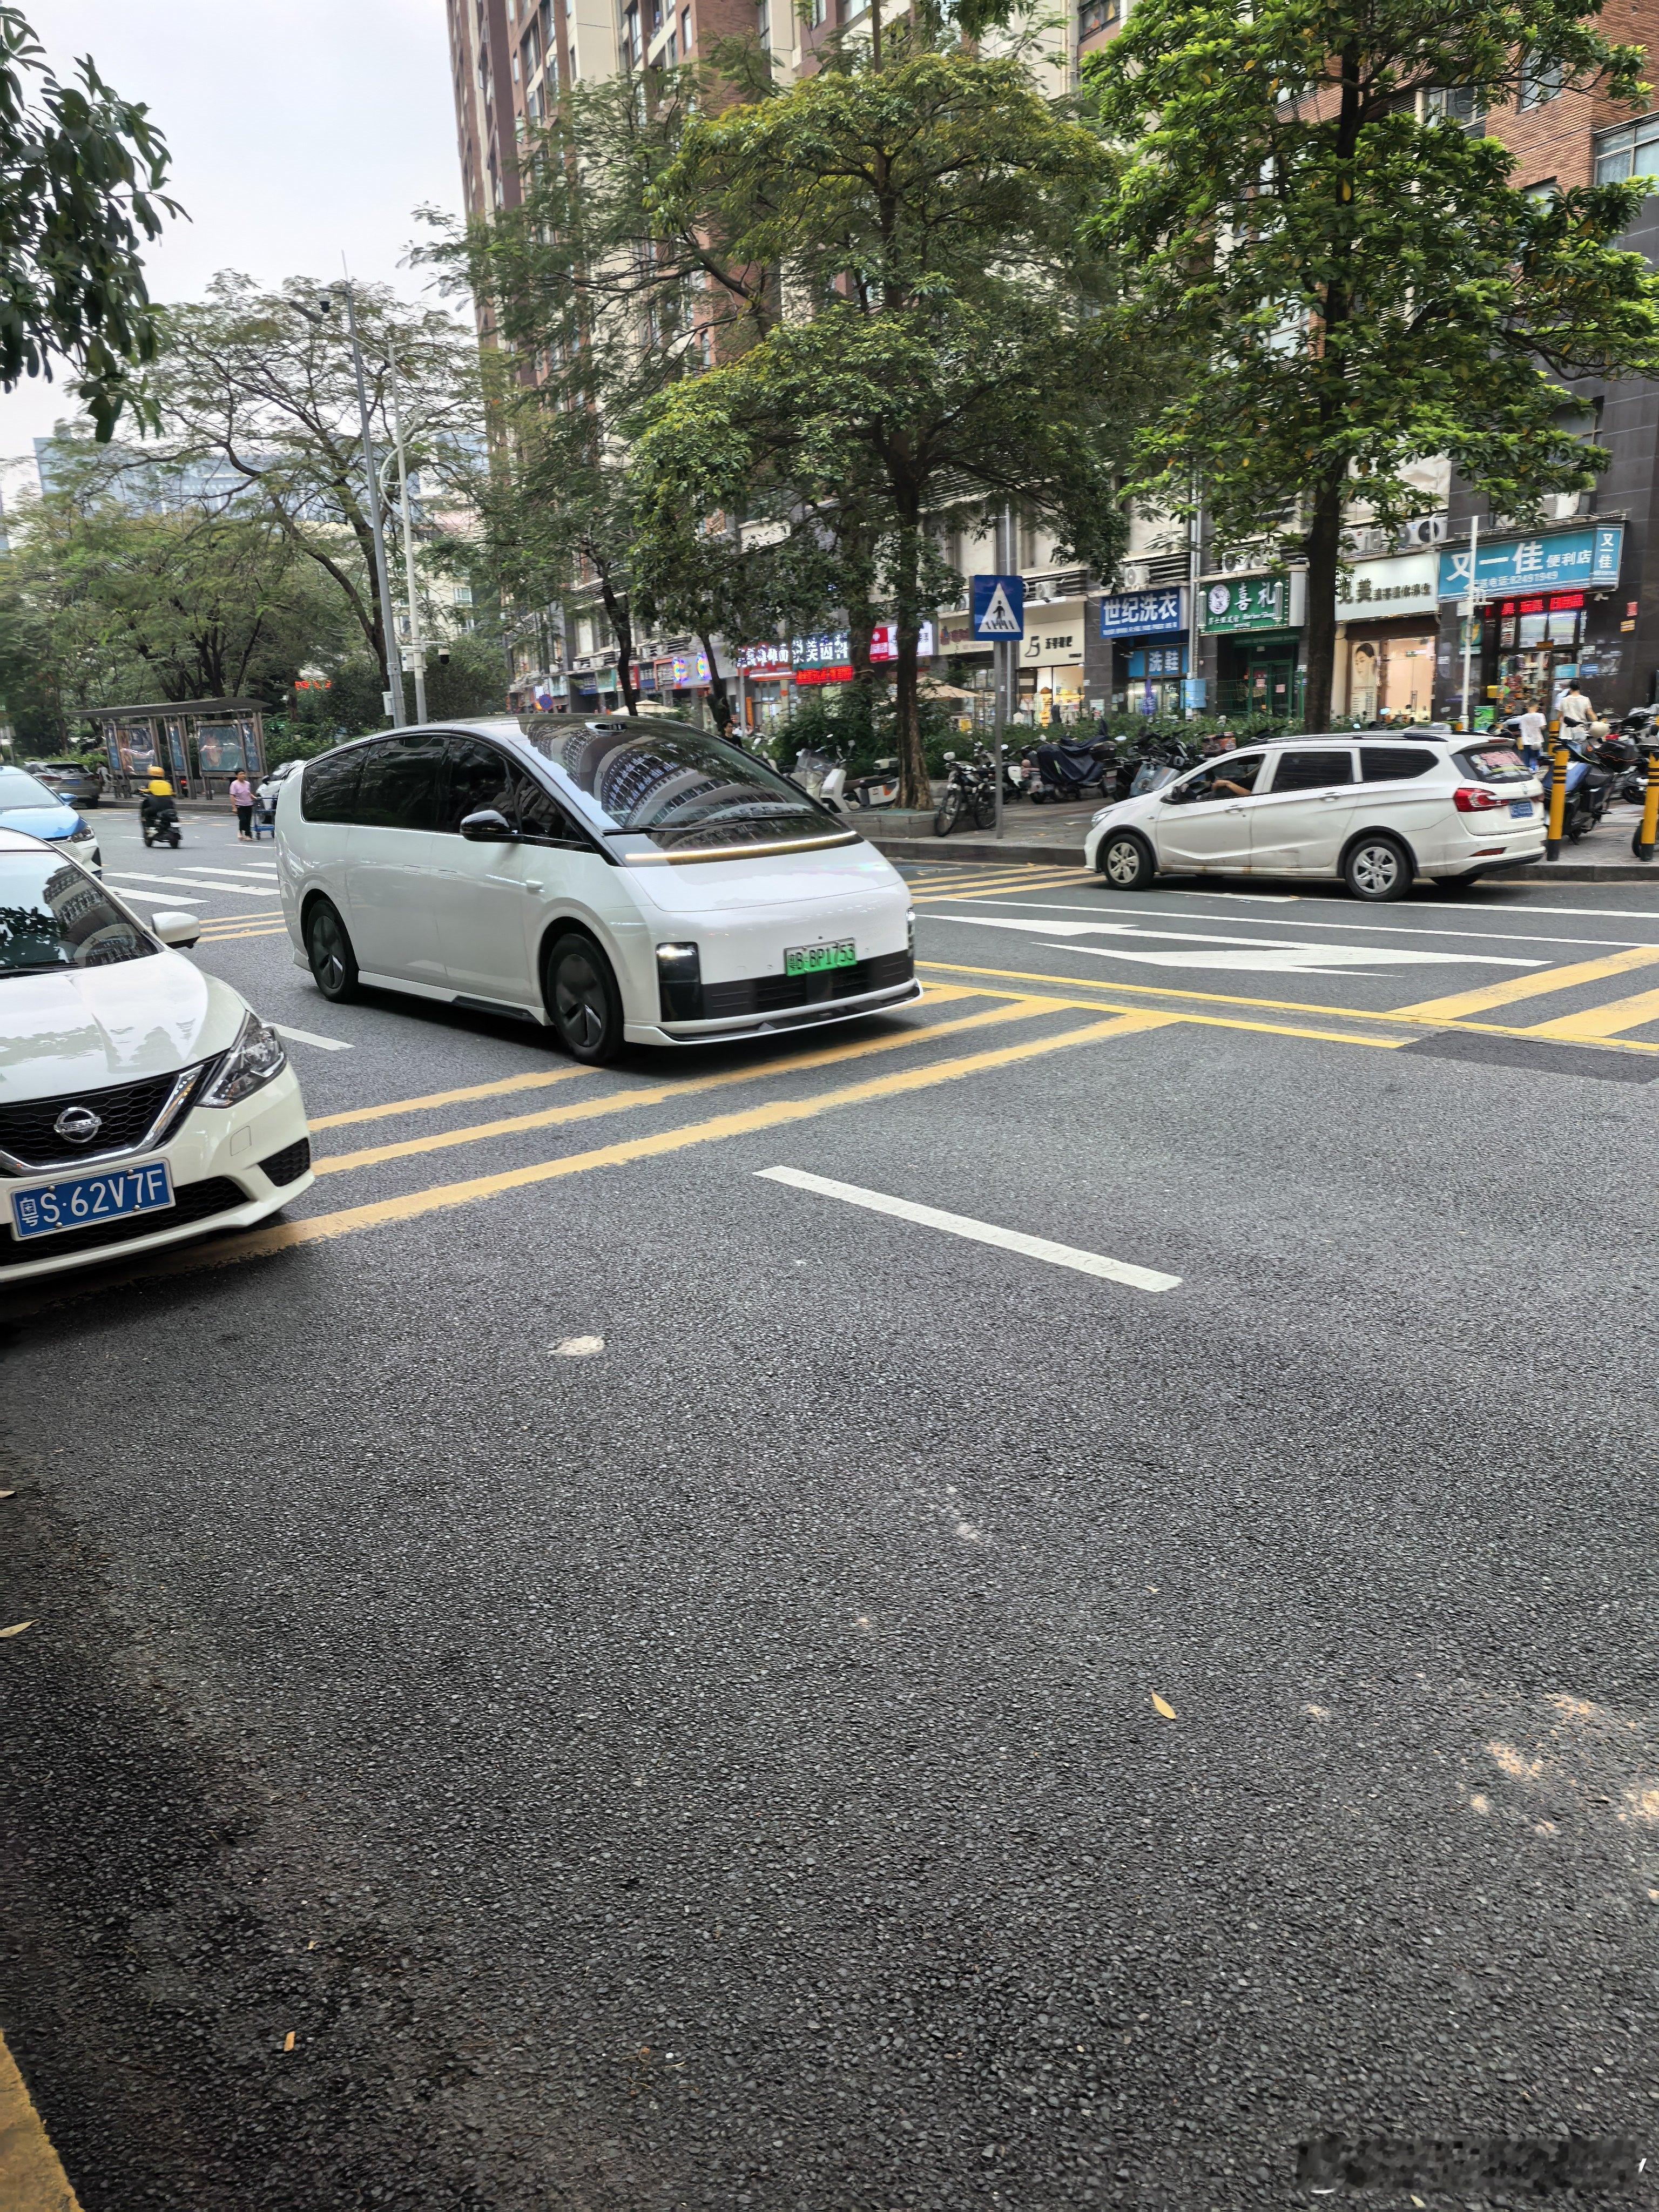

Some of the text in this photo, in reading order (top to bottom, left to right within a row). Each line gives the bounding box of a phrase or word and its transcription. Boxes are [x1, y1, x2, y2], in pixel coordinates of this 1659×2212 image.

[1445, 541, 1592, 582] 又一佳 便利店
[1599, 533, 1615, 569] 又一佳
[1103, 591, 1178, 625] 世纪洗衣
